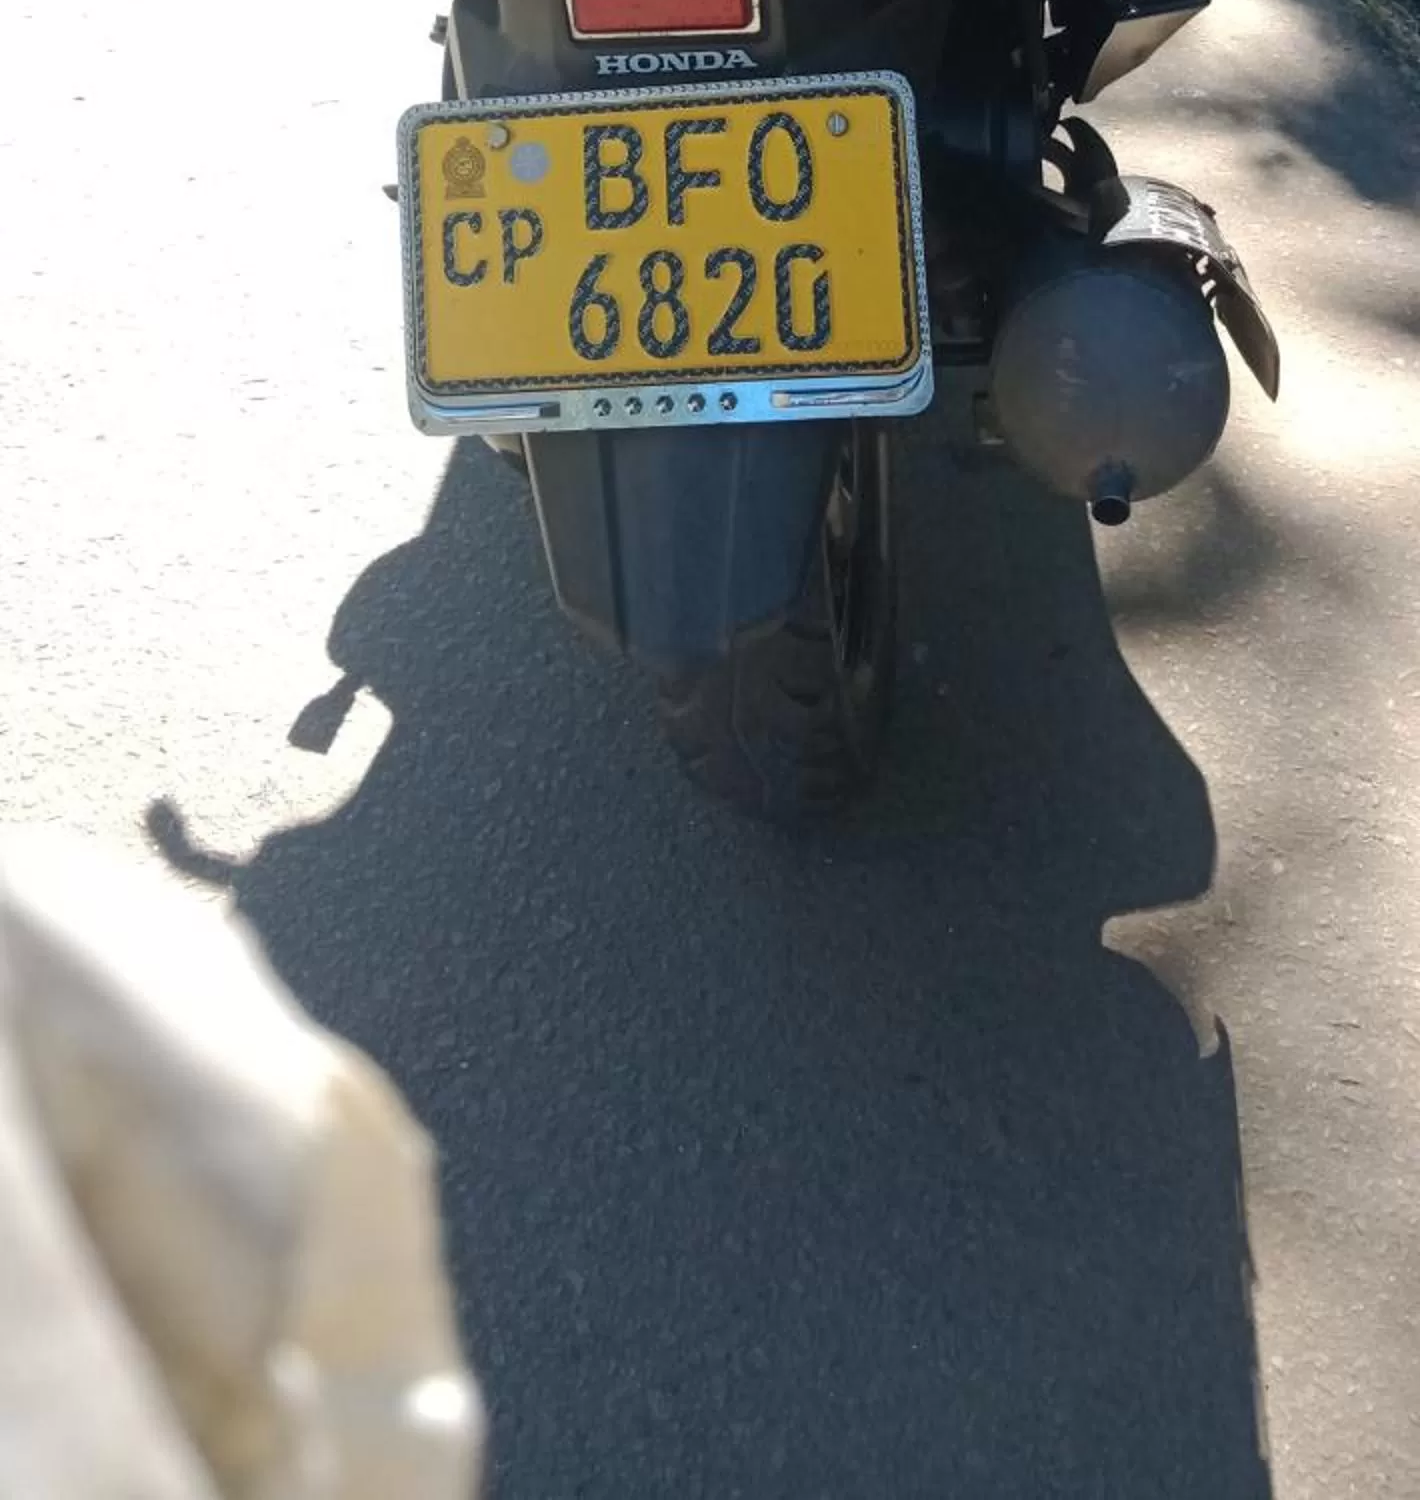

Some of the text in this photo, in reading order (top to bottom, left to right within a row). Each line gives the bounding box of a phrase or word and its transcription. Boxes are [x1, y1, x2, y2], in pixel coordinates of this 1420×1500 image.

[595, 49, 758, 75] HONDA
[582, 111, 815, 231] BFO
[442, 207, 544, 287] CP
[568, 243, 834, 361] 6820
